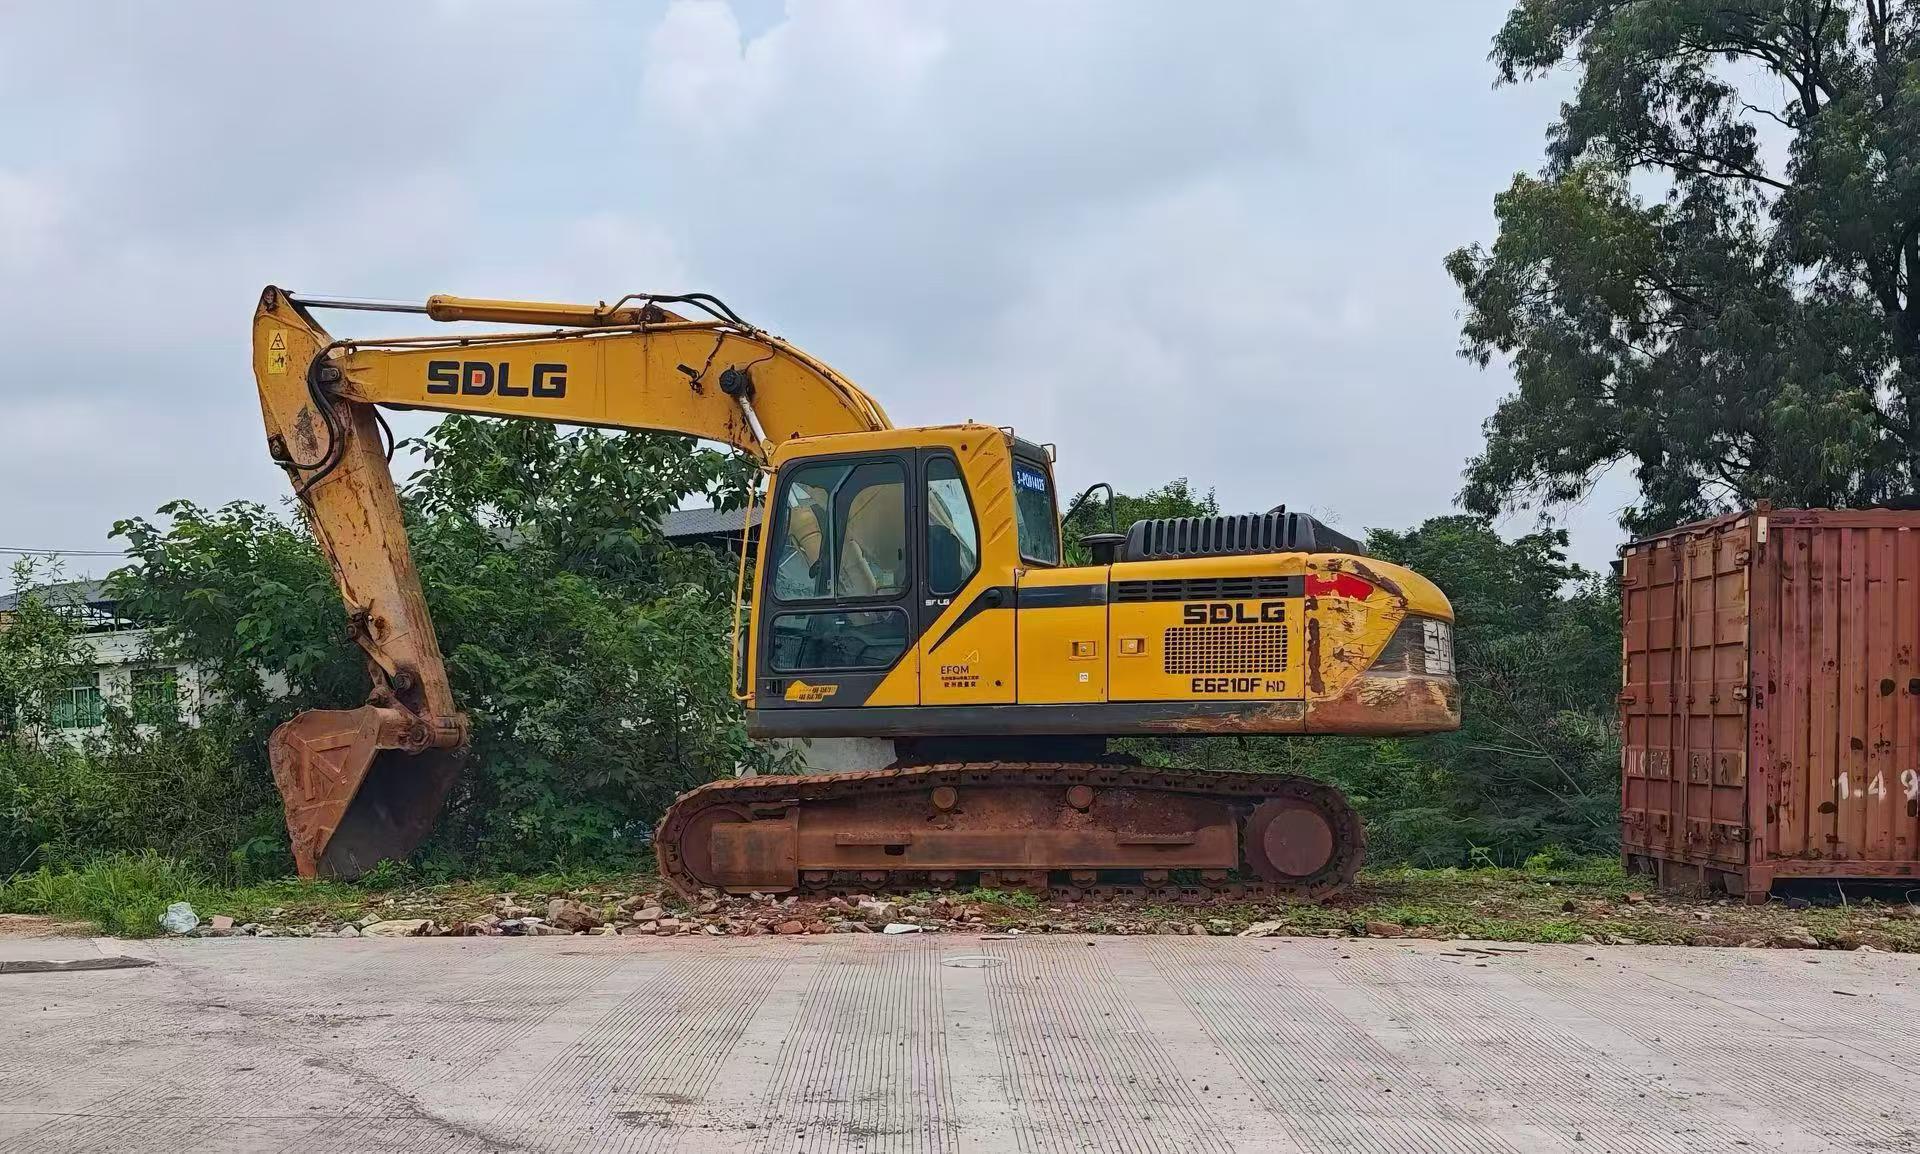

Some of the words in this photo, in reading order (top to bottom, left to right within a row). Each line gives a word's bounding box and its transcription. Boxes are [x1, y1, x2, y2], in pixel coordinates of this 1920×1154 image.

[427, 360, 568, 399] SDLG
[1183, 601, 1286, 624] SDLG
[940, 665, 970, 675] EFQM
[1191, 678, 1262, 693] E6210F
